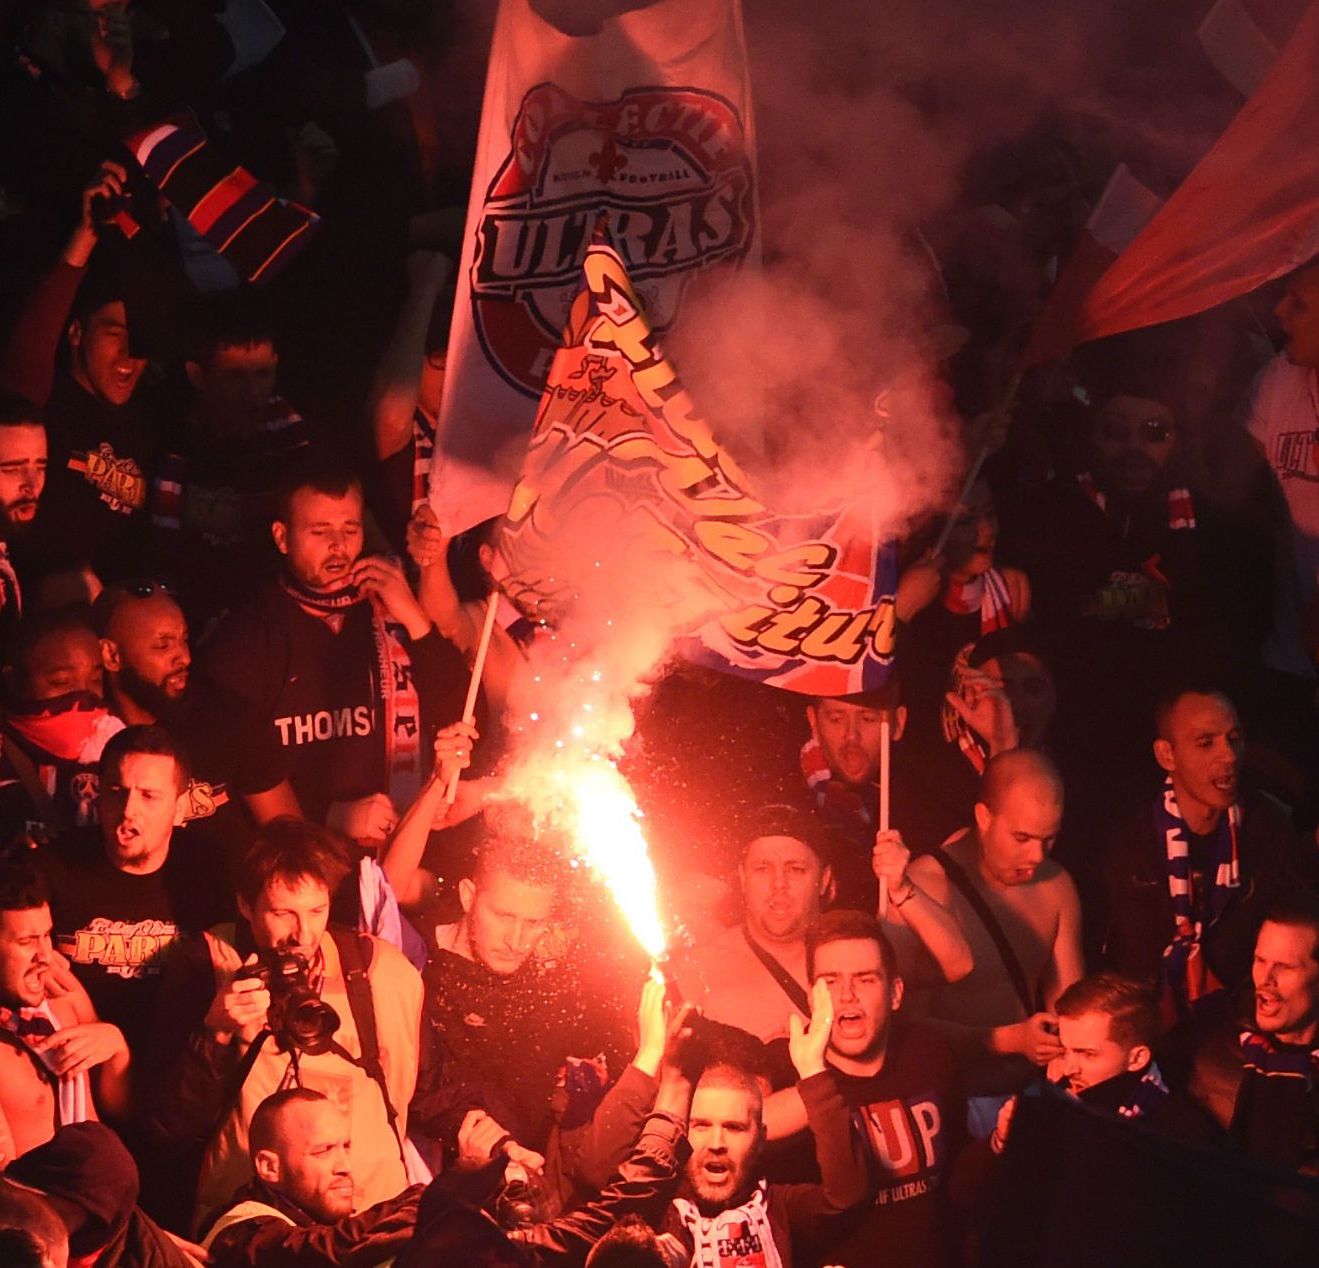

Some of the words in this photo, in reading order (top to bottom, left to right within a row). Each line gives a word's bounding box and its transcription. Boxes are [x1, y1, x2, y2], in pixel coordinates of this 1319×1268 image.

[493, 187, 731, 276] ULTRAS
[274, 705, 375, 746] THOMS
[870, 1101, 941, 1170] UP
